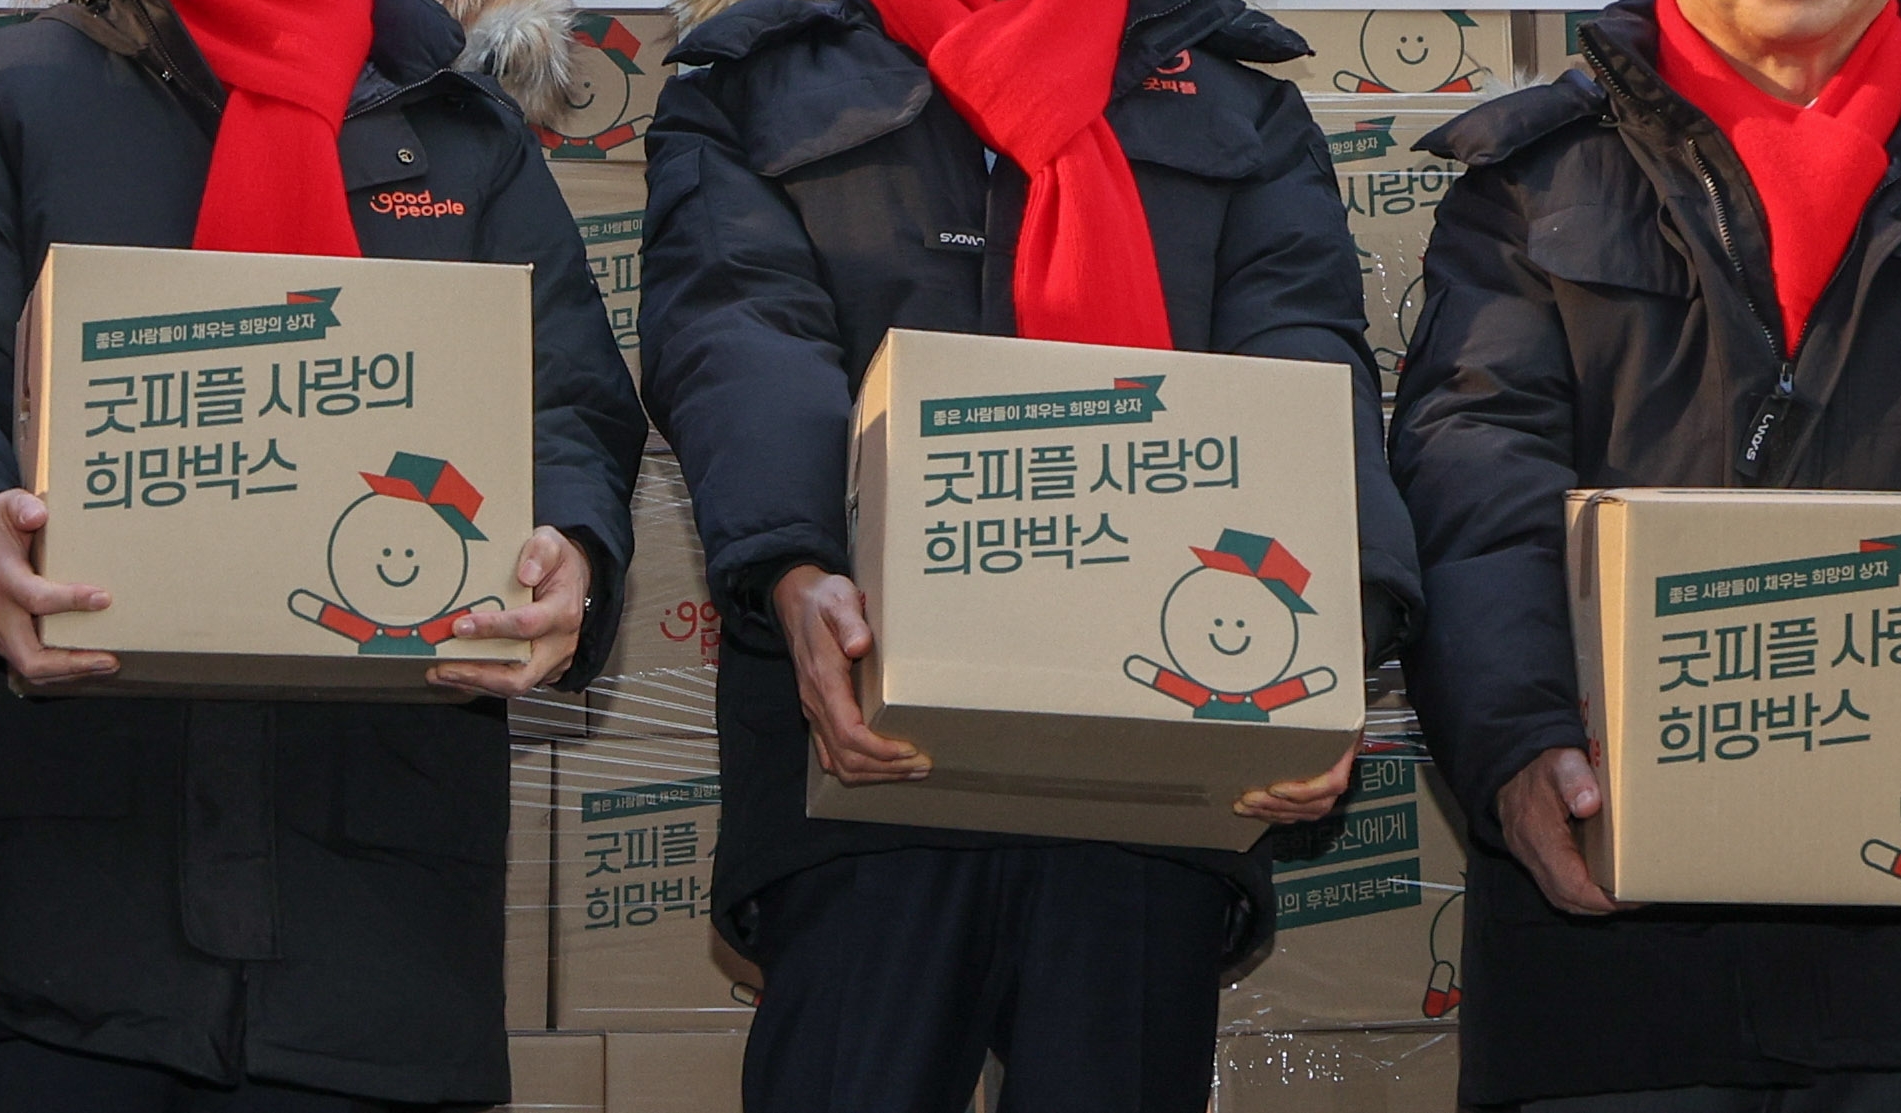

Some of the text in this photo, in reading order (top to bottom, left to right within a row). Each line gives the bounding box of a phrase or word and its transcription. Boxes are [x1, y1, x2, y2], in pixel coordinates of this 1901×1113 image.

[1328, 140, 1353, 155] 망의
[370, 190, 432, 213] good
[395, 199, 465, 220] people
[96, 312, 316, 350] 좋은 사람들이 채우는 희망의 상자
[85, 352, 413, 437] 굿피플 사랑의
[933, 397, 1142, 426] 좋은 사람들이 채우는 희망의 상자
[84, 439, 297, 509] 희망박스
[924, 436, 1238, 507] 굿피플 사랑의
[924, 513, 1129, 574] 희망박스
[1669, 560, 1889, 604] 좋은 사람들이 채우는 희망의 상자
[1659, 618, 1818, 692] 굿피플
[1658, 689, 1870, 764] 희망박스
[584, 821, 700, 878] 굿피플
